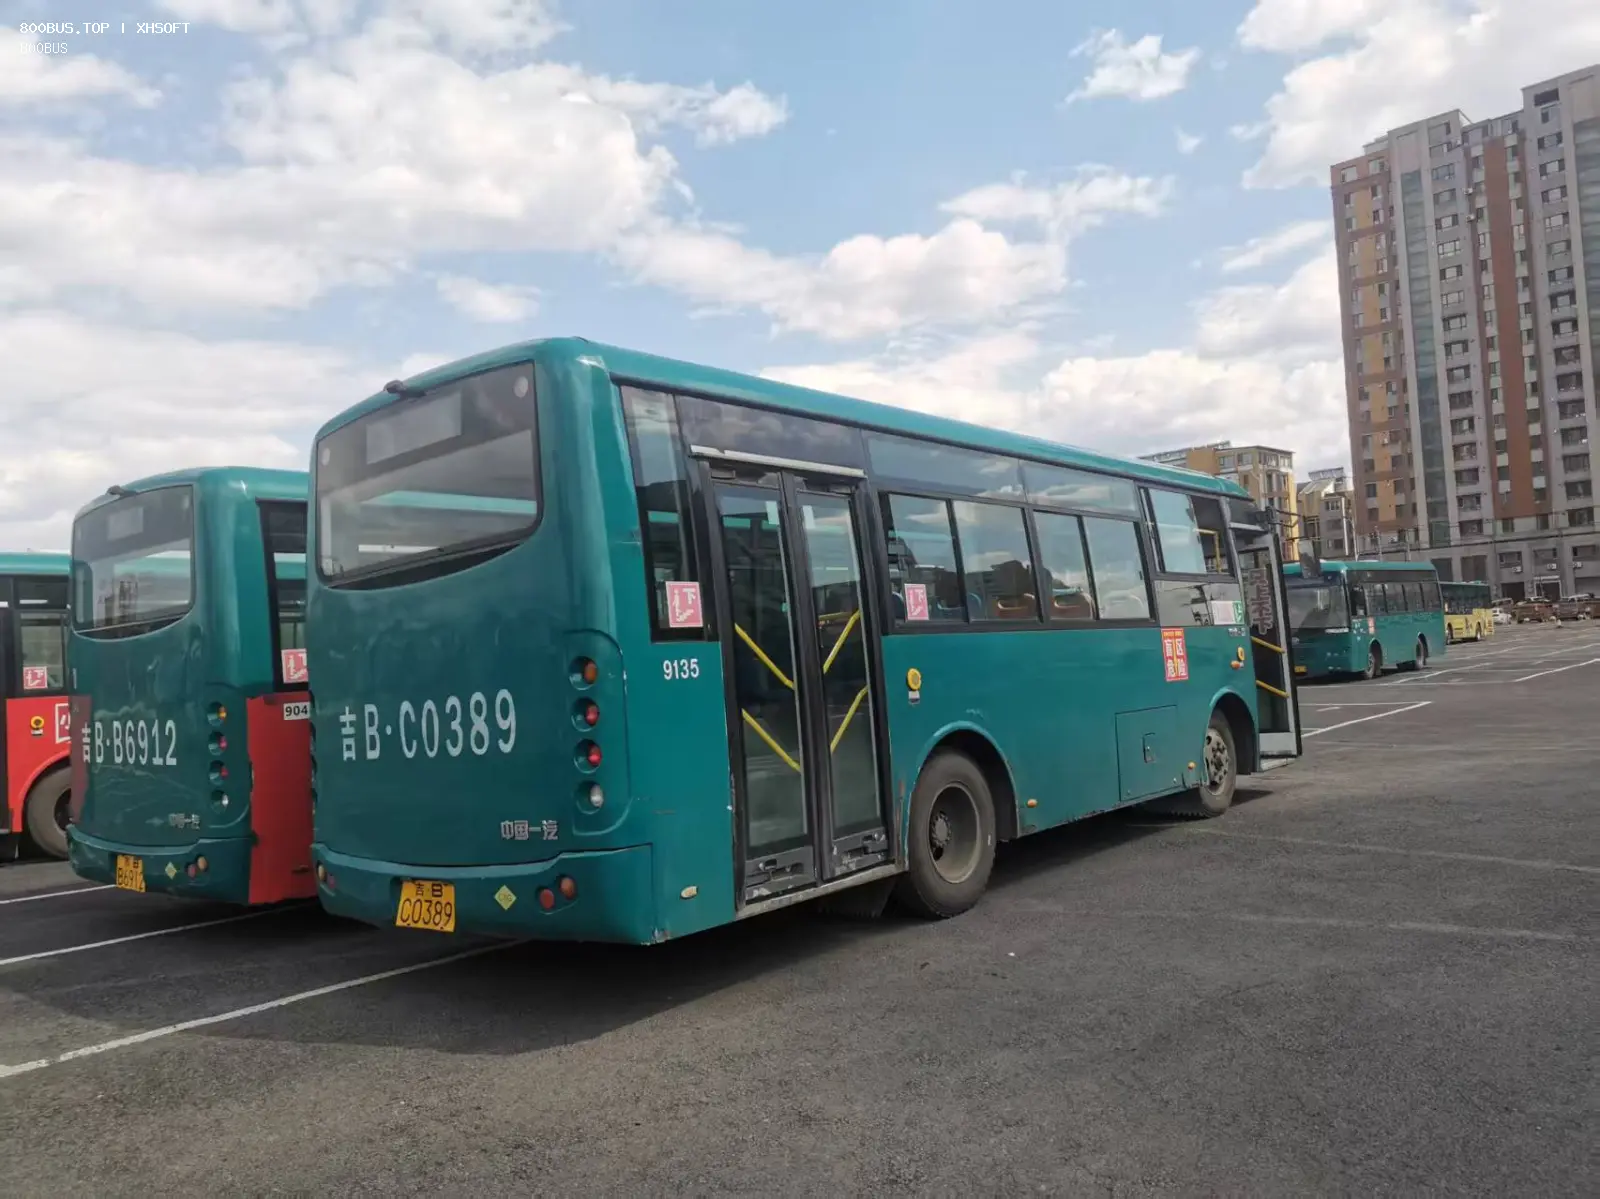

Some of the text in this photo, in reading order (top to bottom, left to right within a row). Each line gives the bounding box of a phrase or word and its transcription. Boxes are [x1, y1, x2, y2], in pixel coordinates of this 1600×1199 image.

[663, 659, 699, 680] 9135
[500, 820, 558, 840] 中国一汽
[400, 898, 453, 927] C0389
